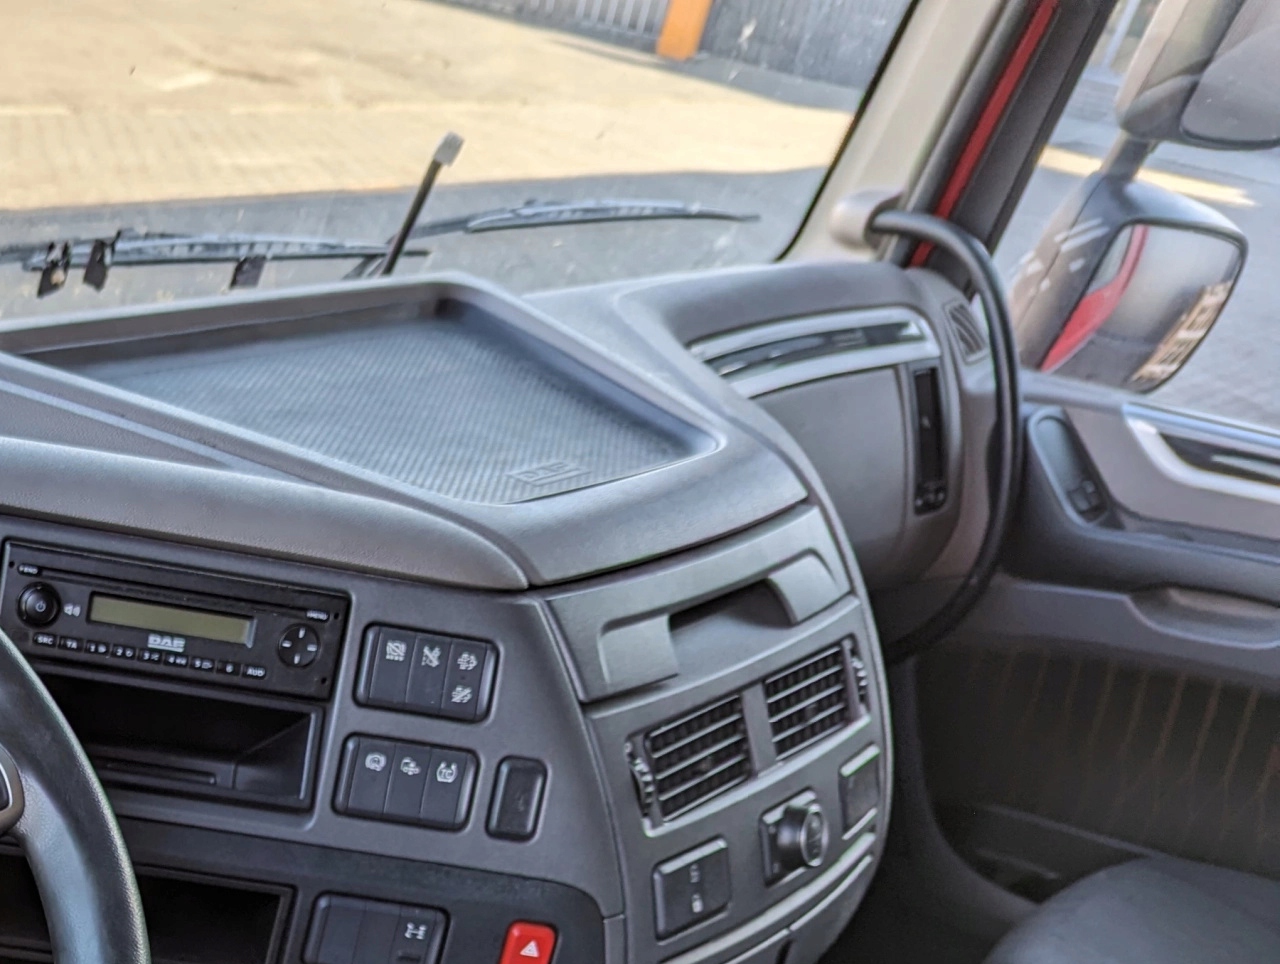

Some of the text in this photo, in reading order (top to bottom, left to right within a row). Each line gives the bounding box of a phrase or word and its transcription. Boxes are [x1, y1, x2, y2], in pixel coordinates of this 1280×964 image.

[36, 634, 54, 646] SRC
[116, 646, 123, 657] 2
[143, 650, 150, 661] 3
[246, 665, 266, 678] AUD
[147, 633, 186, 649] DAF
